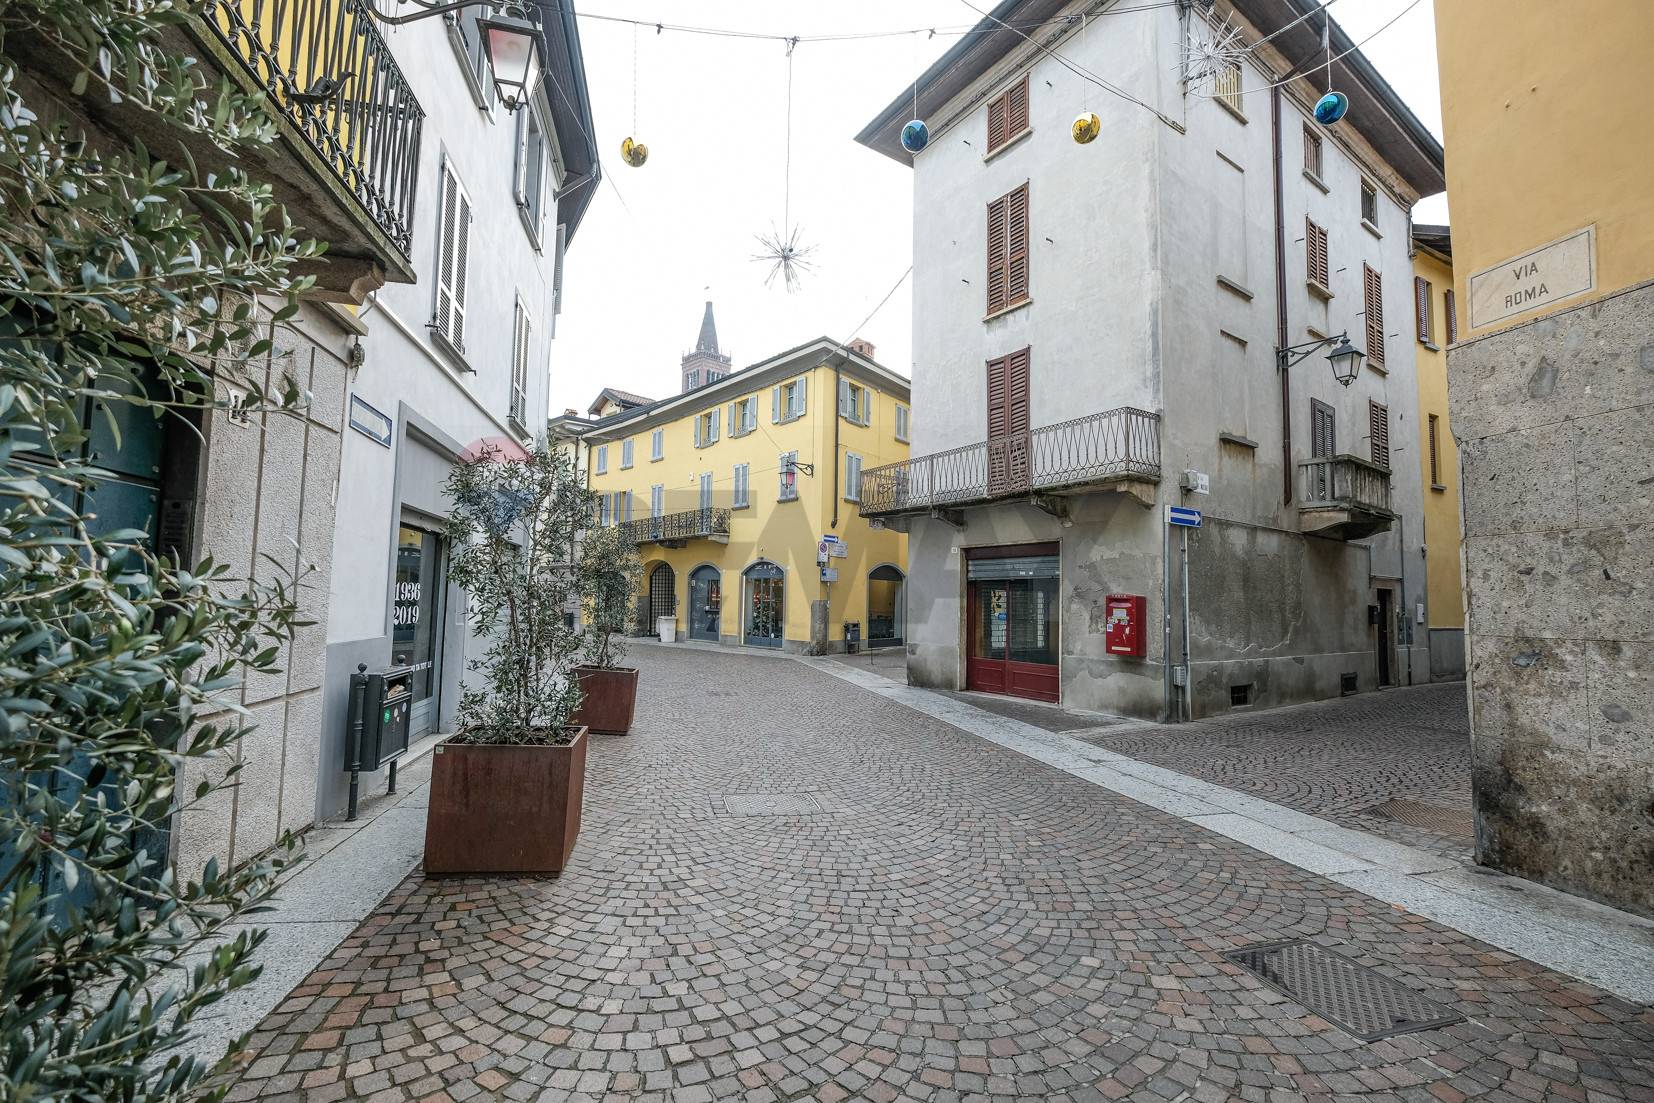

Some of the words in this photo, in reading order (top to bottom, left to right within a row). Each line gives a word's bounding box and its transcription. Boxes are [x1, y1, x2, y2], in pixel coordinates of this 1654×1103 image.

[1512, 262, 1539, 280] VIA
[1505, 282, 1549, 309] ROMA
[395, 581, 420, 601] 1936
[393, 605, 419, 625] 2019
